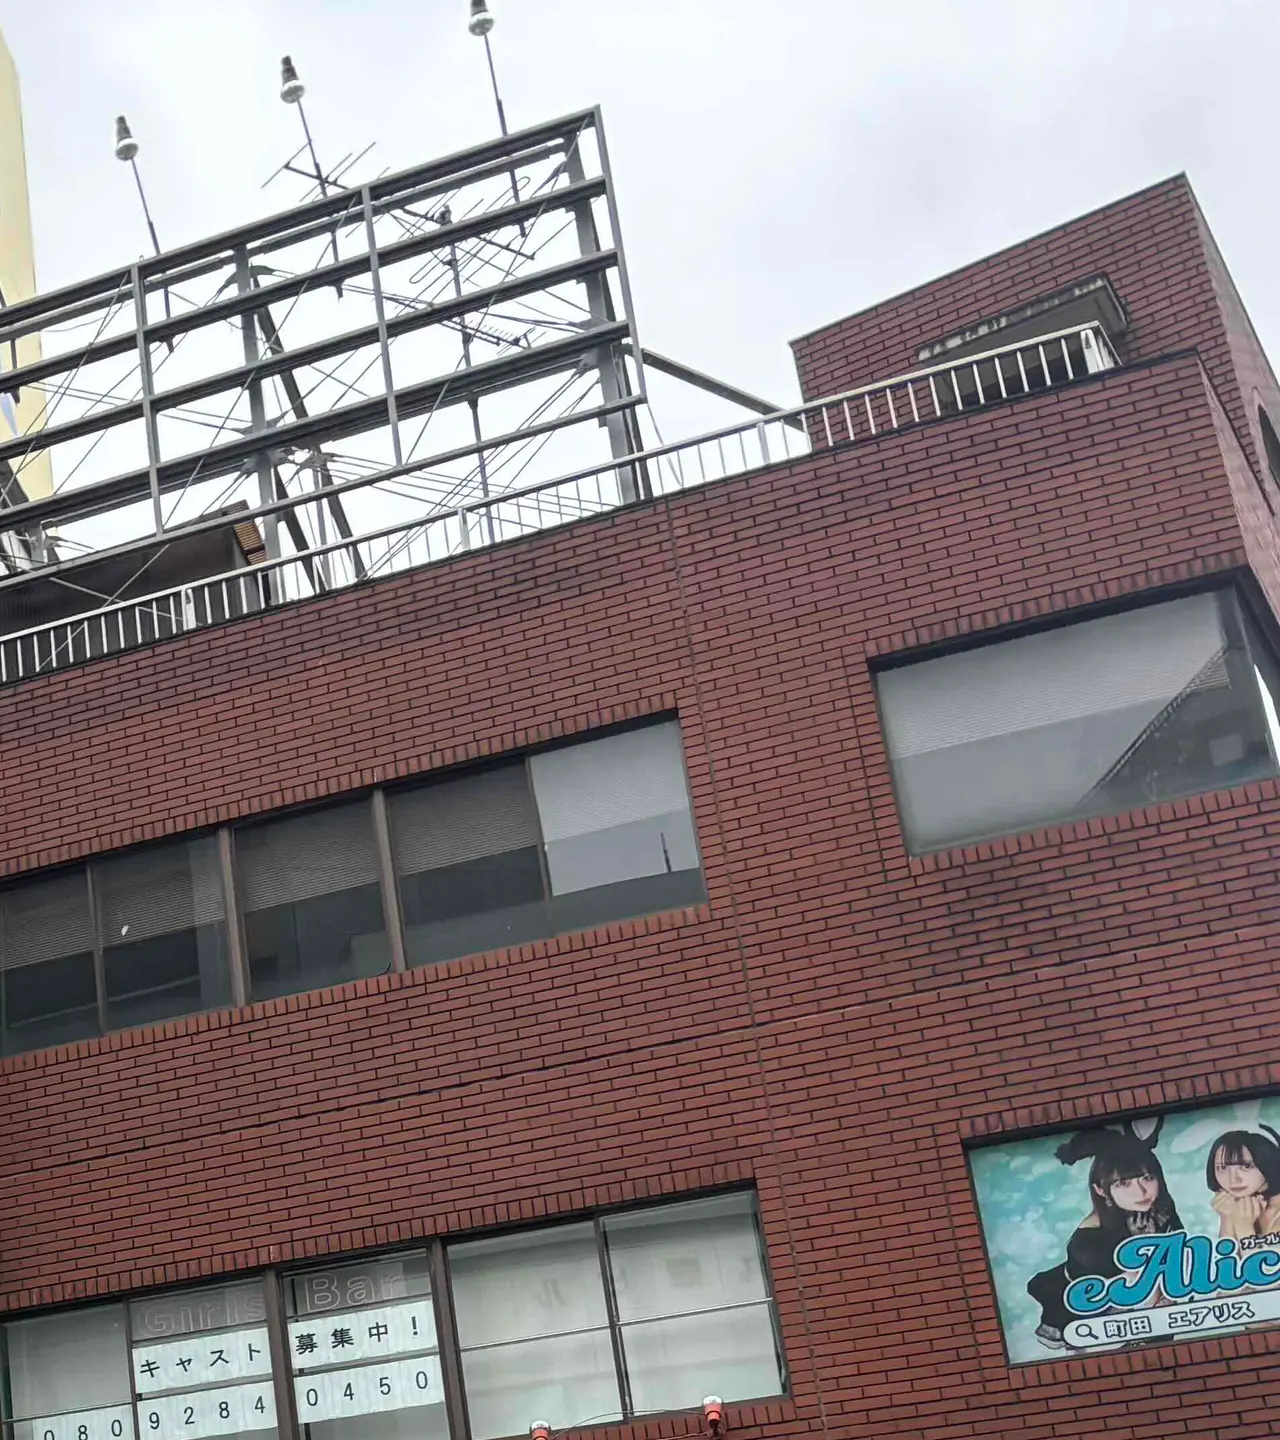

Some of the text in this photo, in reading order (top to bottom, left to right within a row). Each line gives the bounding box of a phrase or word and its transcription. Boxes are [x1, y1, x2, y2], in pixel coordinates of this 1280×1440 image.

[140, 1316, 419, 1378] キャスト 募集中!
[1104, 1301, 1255, 1338] 町田 エアリス
[149, 1396, 265, 1430] 9284
[306, 1370, 428, 1407] 0450
